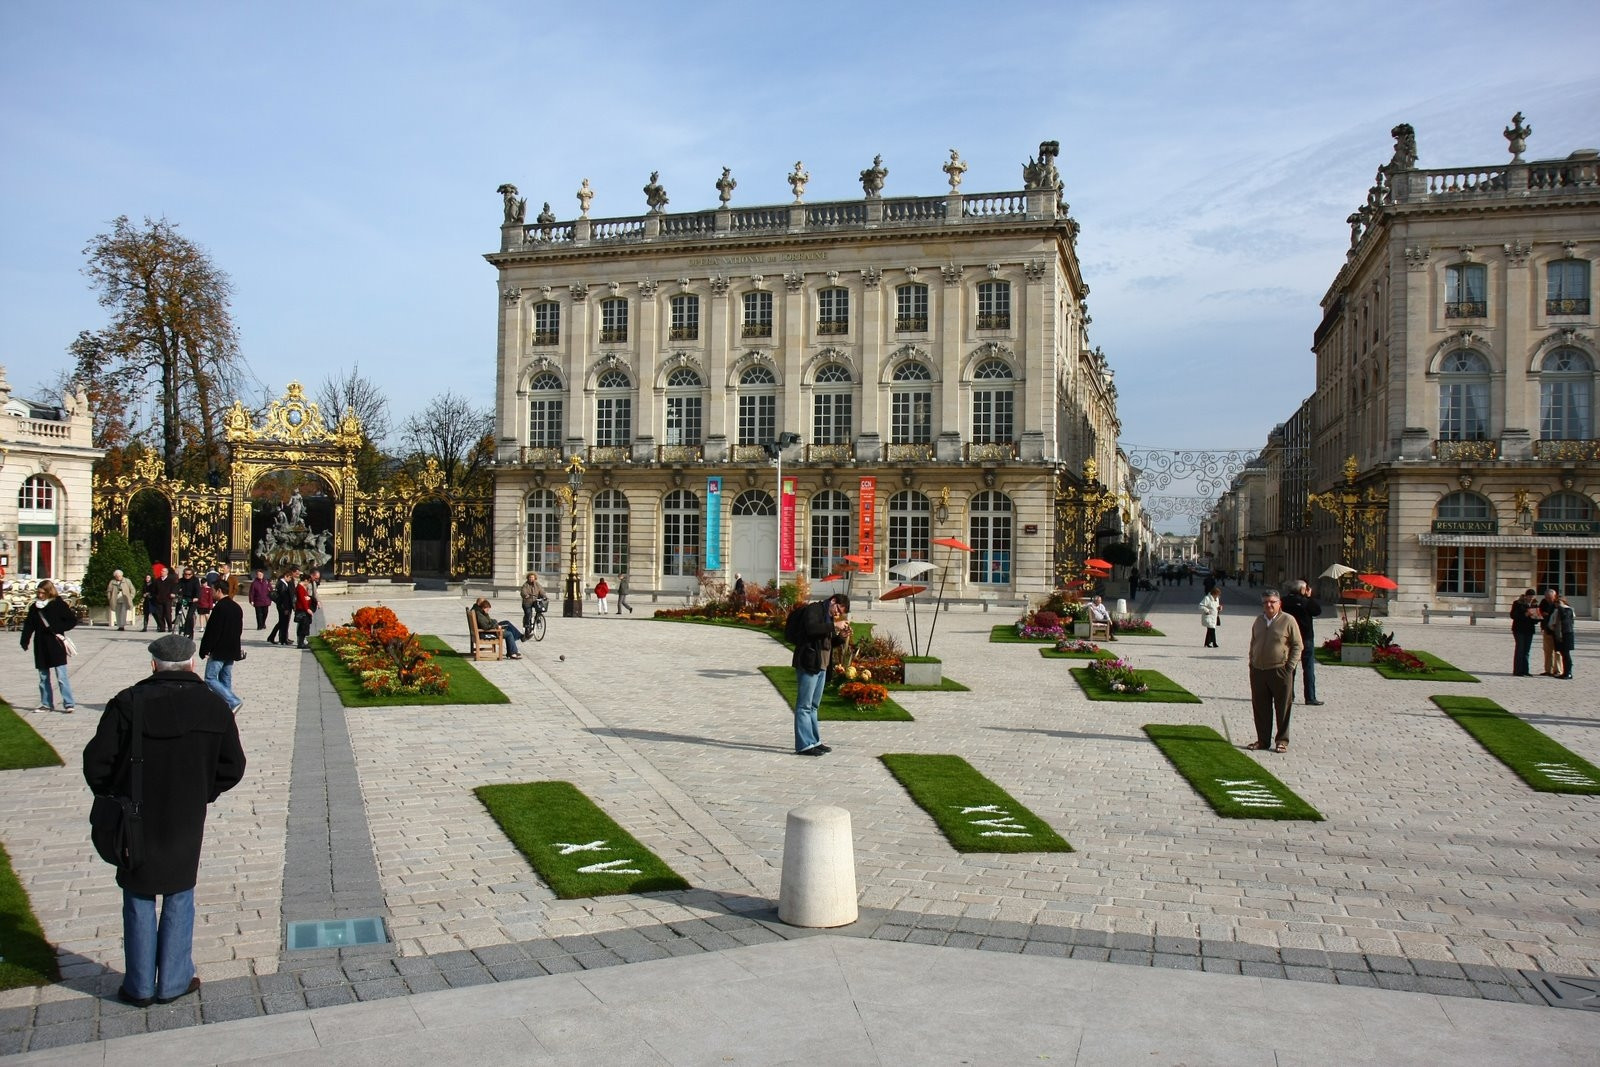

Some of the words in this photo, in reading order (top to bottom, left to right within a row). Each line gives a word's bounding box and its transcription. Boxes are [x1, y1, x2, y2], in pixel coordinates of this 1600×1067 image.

[722, 255, 763, 264] NATIONAL
[778, 252, 827, 262] LORRAINE
[1436, 522, 1493, 530] RESTAURANT
[1543, 523, 1591, 531] STANISLAS
[1215, 778, 1285, 807] XVII
[949, 804, 1033, 837] XVI
[549, 840, 642, 874] XV
